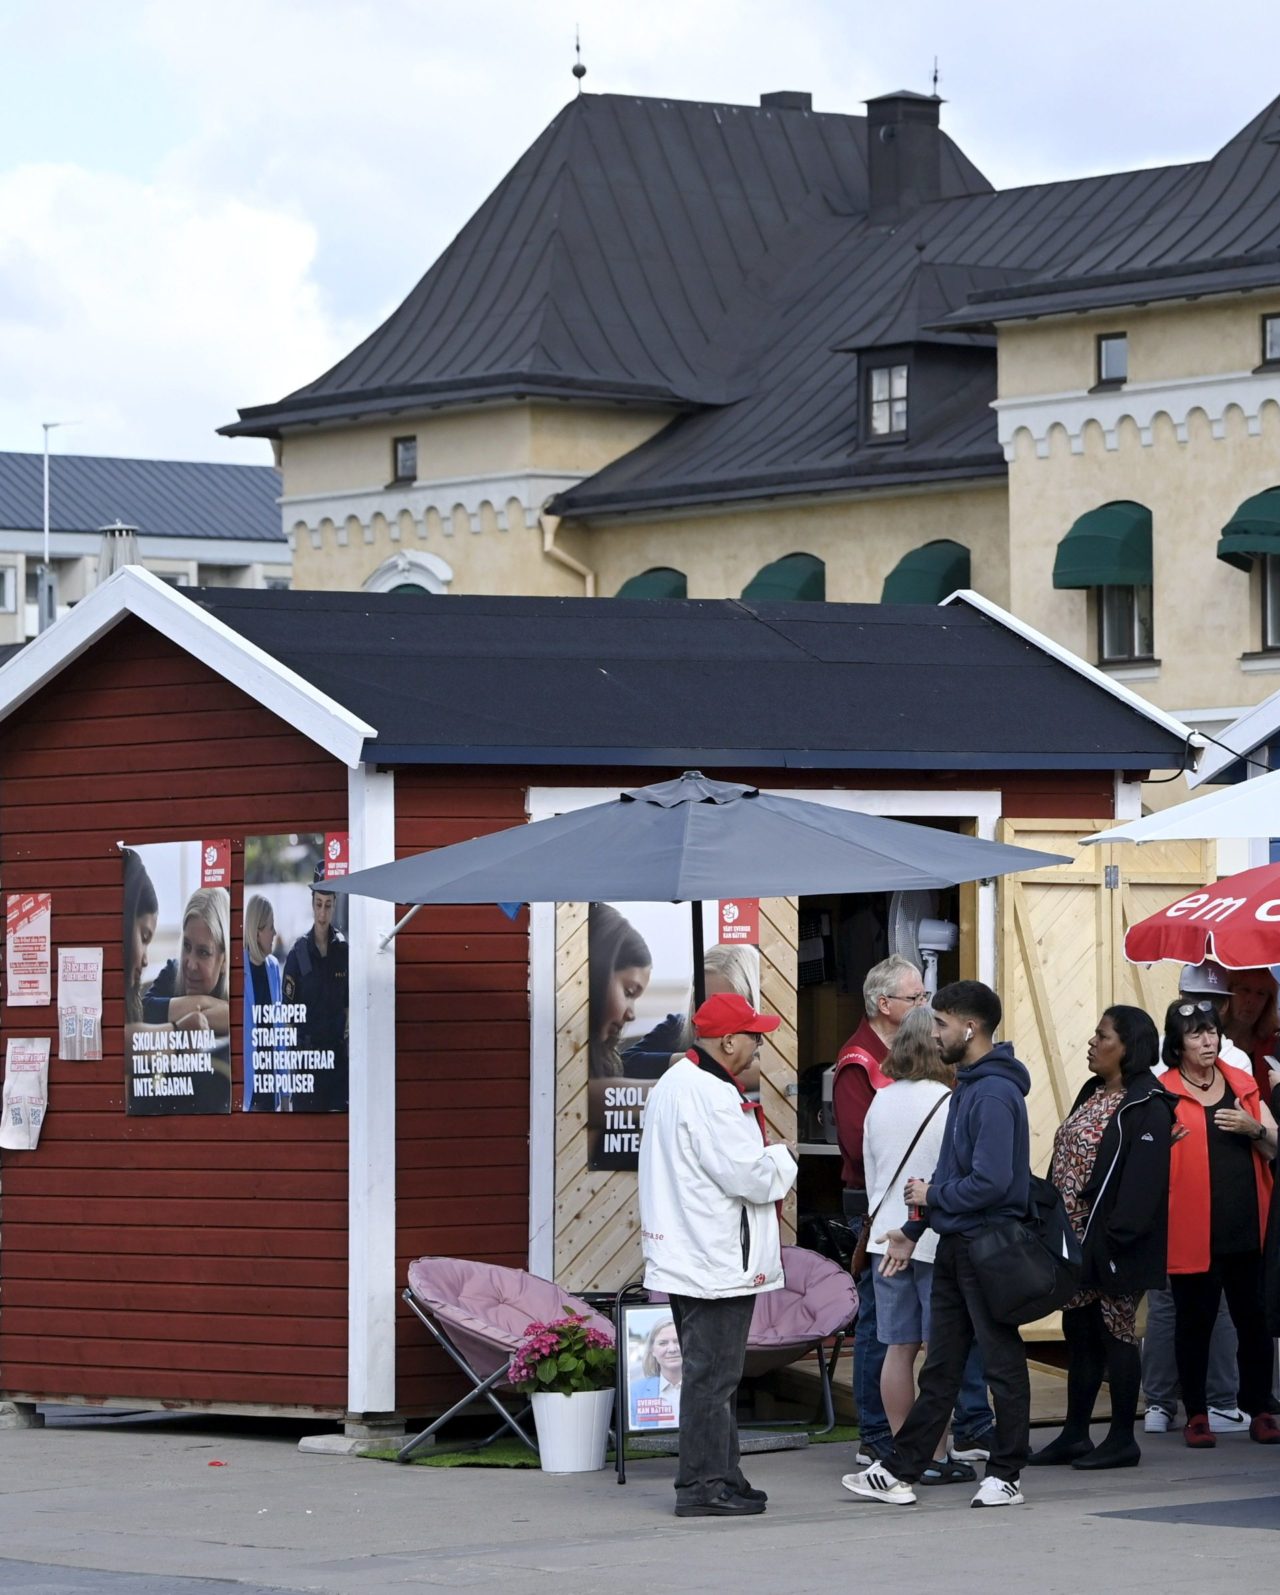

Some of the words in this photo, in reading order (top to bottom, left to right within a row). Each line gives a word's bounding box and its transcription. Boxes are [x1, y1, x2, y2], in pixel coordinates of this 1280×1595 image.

[252, 1004, 262, 1023] VI
[263, 1002, 306, 1023] SKÄRPER
[132, 1031, 168, 1051] SKOLAN
[169, 1031, 189, 1049] SKA
[190, 1030, 216, 1049] VARA
[252, 1027, 297, 1046] STRAFFEN
[132, 1055, 150, 1074] TILL
[152, 1052, 170, 1074] FÖR
[171, 1053, 214, 1075] BARNEN,
[252, 1051, 271, 1070] OCH
[274, 1050, 334, 1070] REKRYTERAR
[134, 1078, 154, 1097] INTE
[154, 1075, 194, 1096] ÄGARNA
[253, 1075, 275, 1093] FLER
[276, 1074, 314, 1093] POLISER
[605, 1087, 646, 1107] SKOL
[604, 1110, 640, 1129] TILL
[604, 1134, 639, 1153] INTE
